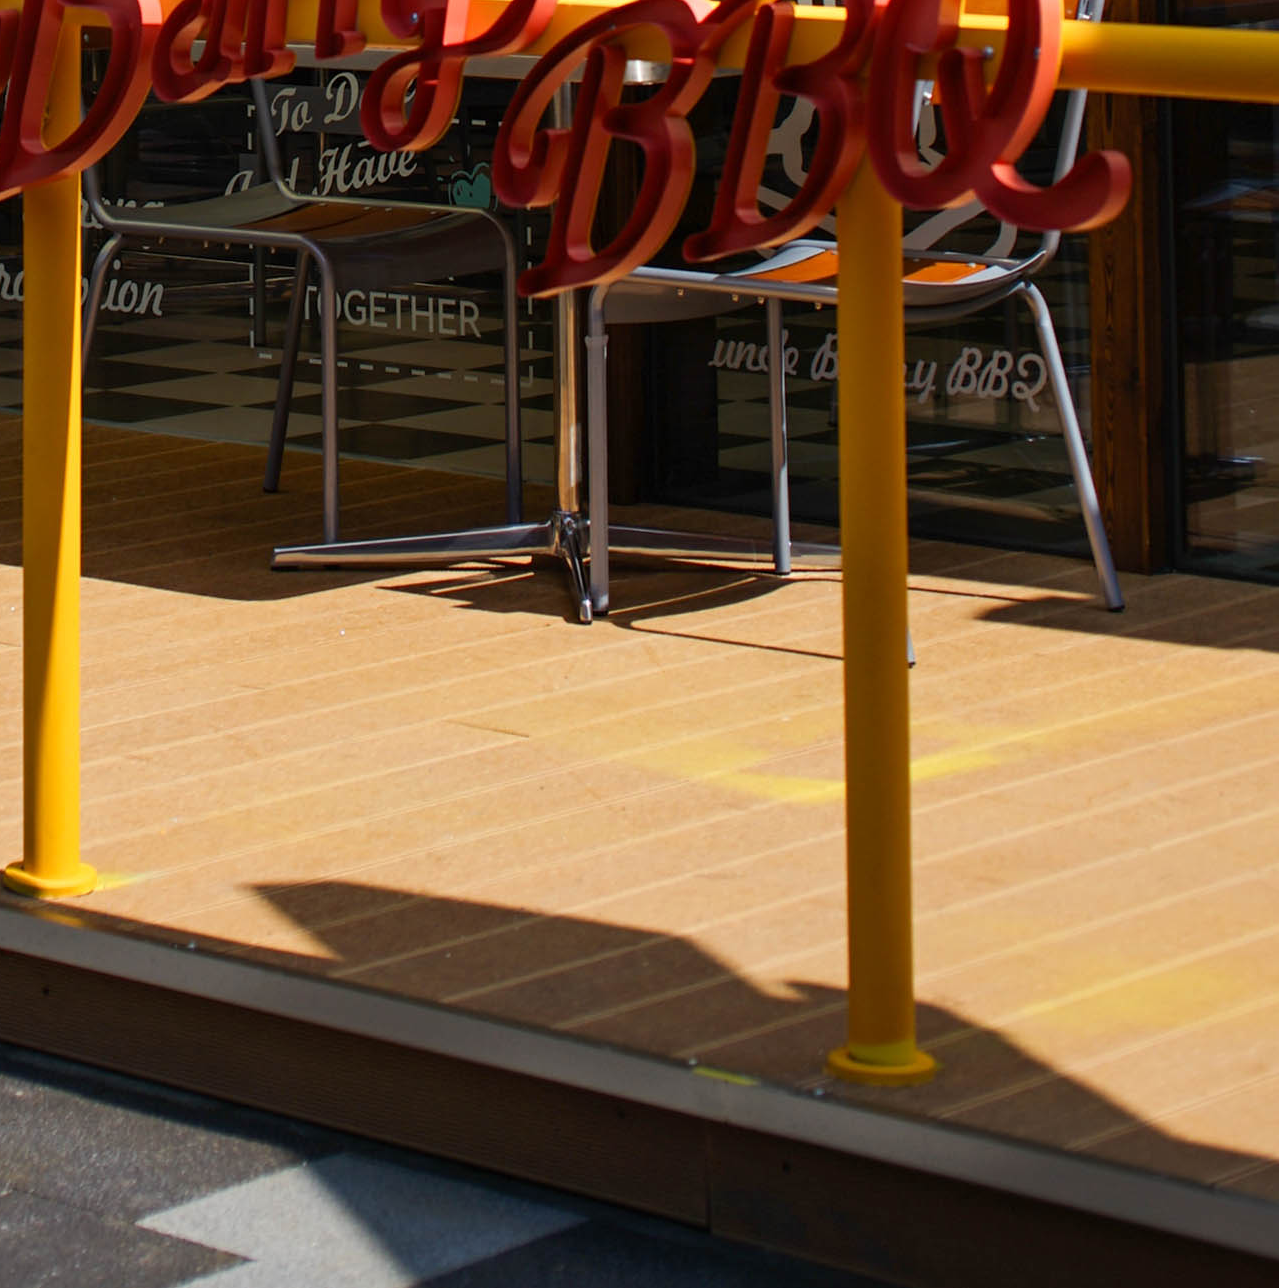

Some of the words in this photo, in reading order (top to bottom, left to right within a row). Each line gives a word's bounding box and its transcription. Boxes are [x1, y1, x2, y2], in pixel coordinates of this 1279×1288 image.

[271, 87, 313, 137] To
[318, 143, 417, 197] Have
[946, 347, 1048, 413] BBQ
